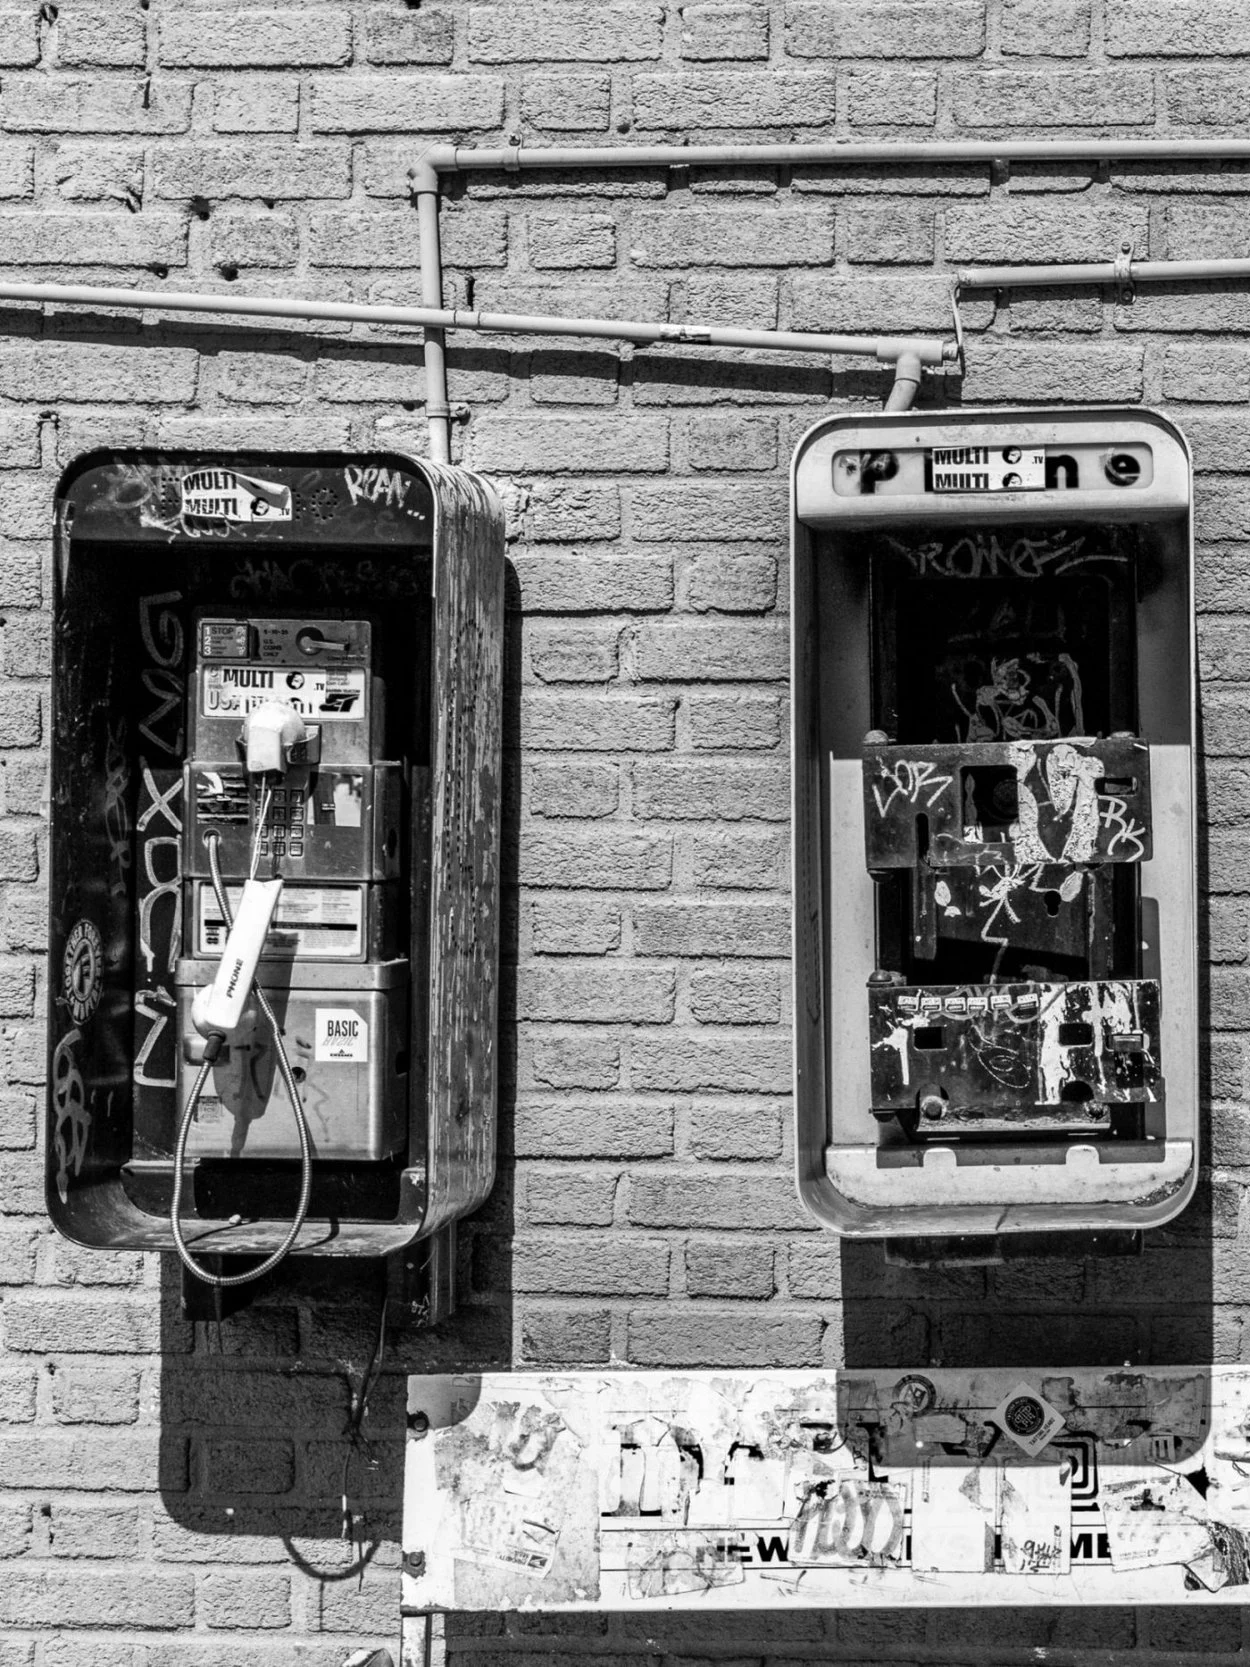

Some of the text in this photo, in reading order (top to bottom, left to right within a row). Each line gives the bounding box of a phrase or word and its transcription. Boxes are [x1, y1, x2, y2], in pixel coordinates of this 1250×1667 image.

[934, 447, 989, 466] MULTI
[184, 471, 237, 492] MULTI
[184, 498, 238, 516] MULTI
[204, 627, 234, 635] 1 STOP
[204, 637, 211, 645] 2
[204, 647, 211, 655] 3
[223, 669, 274, 688] MULTI
[314, 682, 325, 691] .TV
[226, 958, 243, 998] PHONE
[327, 1020, 359, 1037] BASIC
